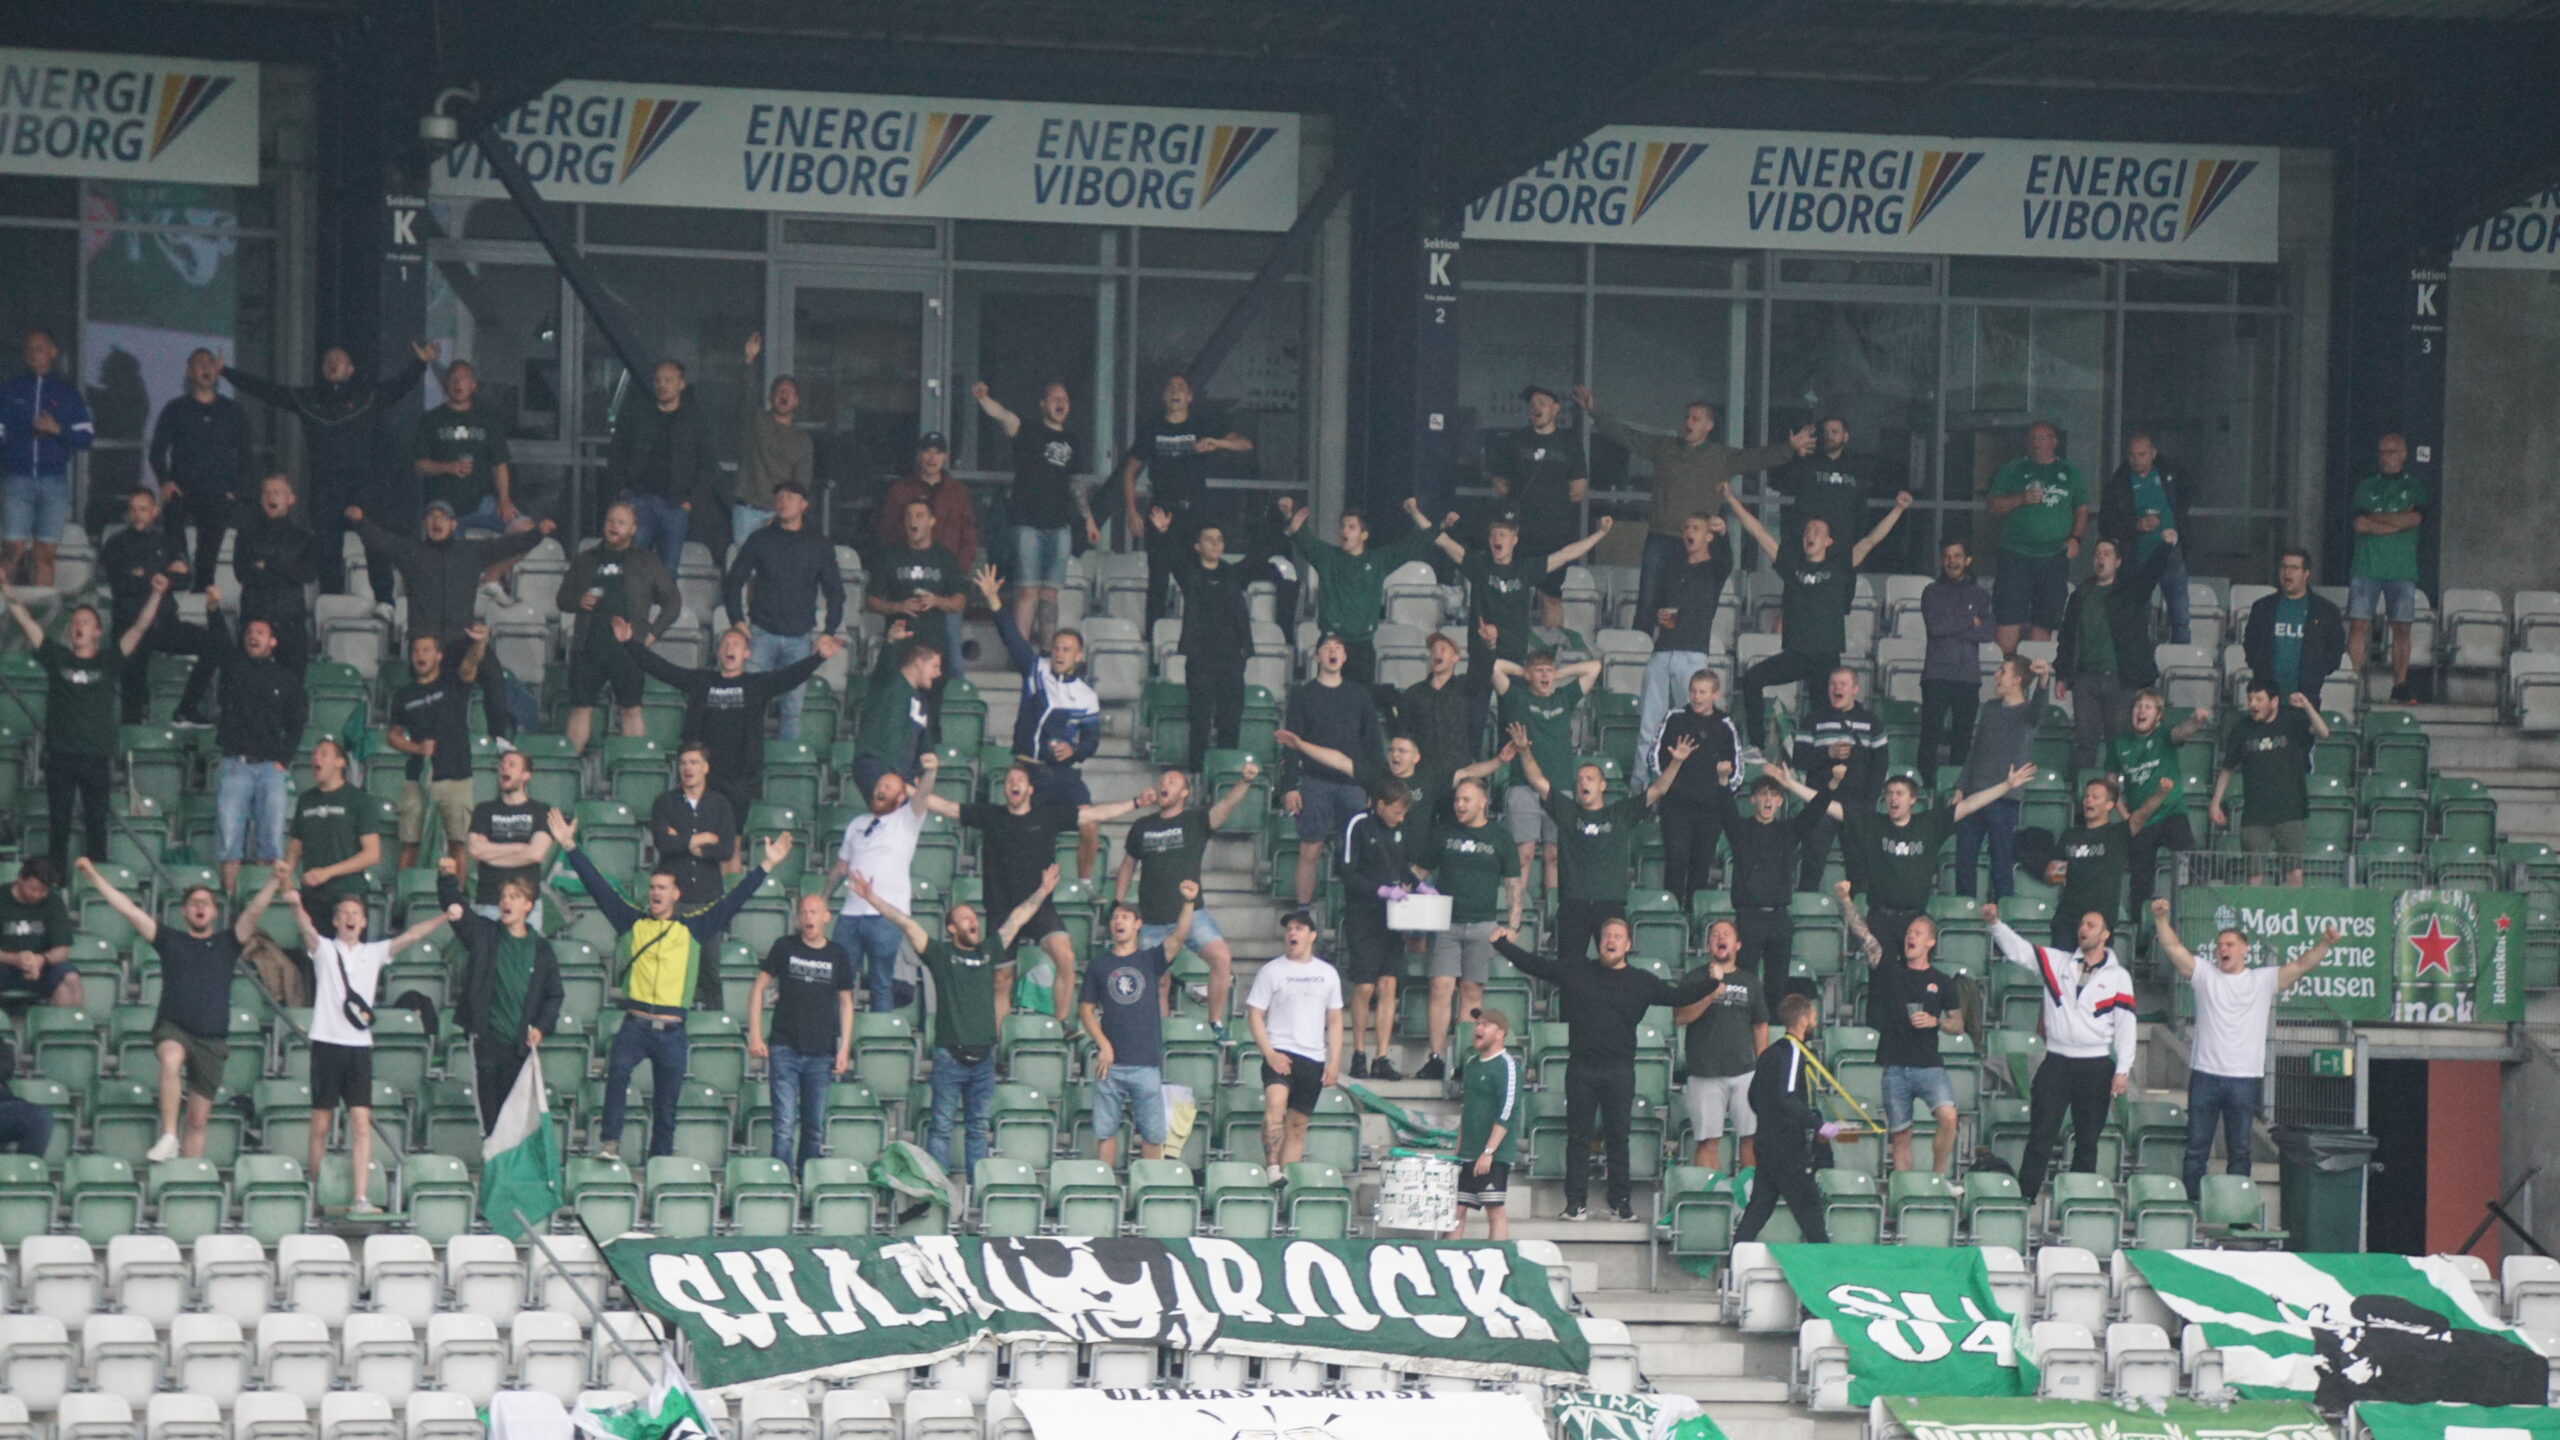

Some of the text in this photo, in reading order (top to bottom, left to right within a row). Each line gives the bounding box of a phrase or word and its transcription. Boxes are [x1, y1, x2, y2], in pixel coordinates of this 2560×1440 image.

[747, 103, 918, 153] ENERGI
[1036, 117, 1204, 165] ENERGI
[446, 140, 616, 184] VIORG
[743, 150, 909, 199] VIBORG
[1750, 145, 1916, 192] ENERGI
[2026, 154, 2189, 199] ENERGI
[1033, 162, 1196, 210] VIBORG
[394, 209, 417, 246] K
[1747, 191, 1906, 235] VIBORG
[2022, 198, 2180, 244] VIBORG
[1430, 253, 1451, 286] K
[2411, 269, 2446, 281] Sektion
[1435, 308, 1445, 323] 2
[2417, 283, 2438, 315] K
[2422, 338, 2431, 353] 3
[2241, 907, 2299, 937] Mød
[2304, 915, 2376, 937] vores
[2493, 935, 2507, 1005] Heineken
